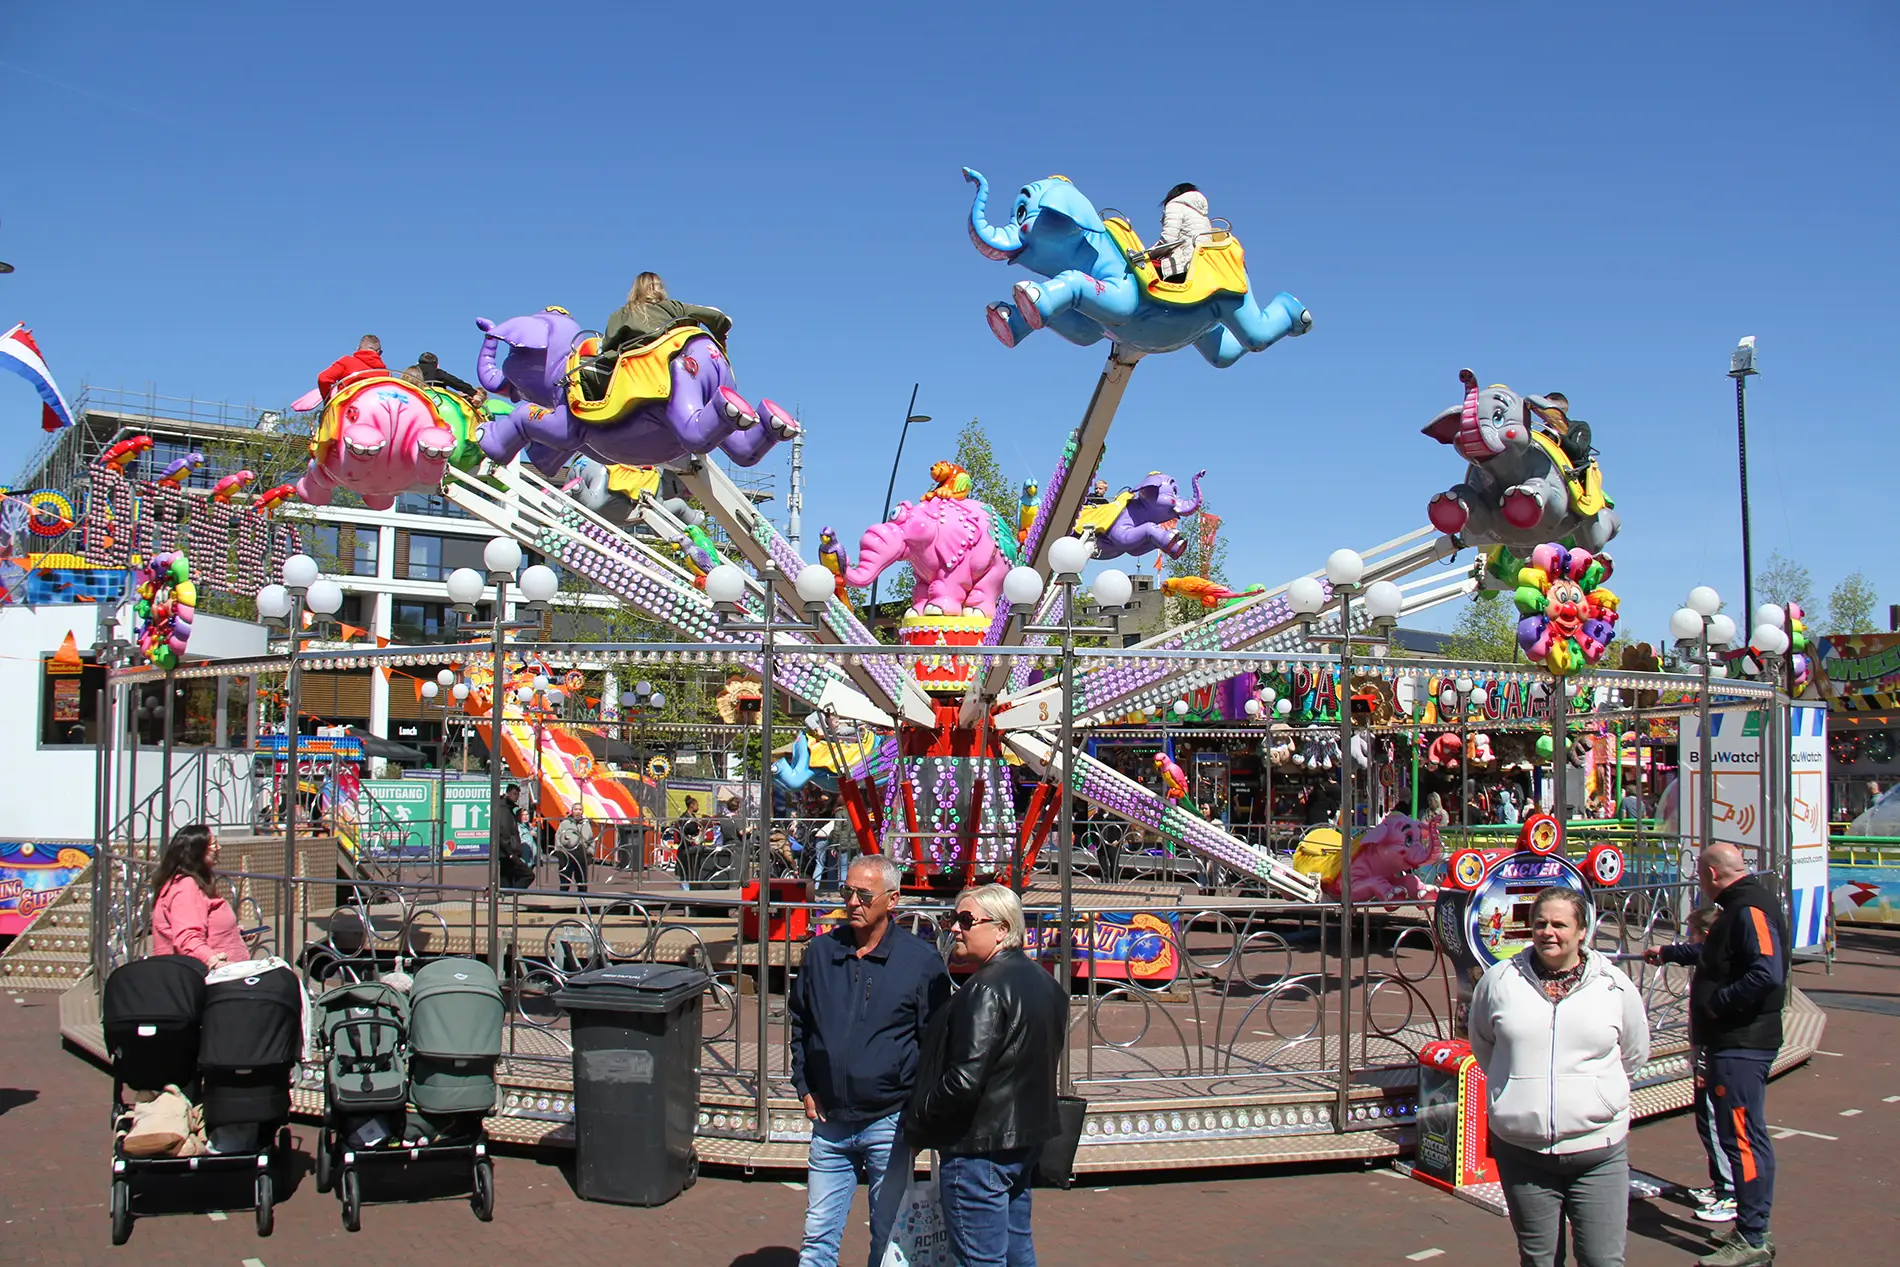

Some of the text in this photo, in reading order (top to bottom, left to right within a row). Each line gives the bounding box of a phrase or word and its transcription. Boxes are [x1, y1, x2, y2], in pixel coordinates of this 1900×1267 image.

[1039, 702, 1049, 721] 3
[399, 726, 418, 736] Lunch
[1690, 752, 1760, 763] BuWatch
[445, 787, 506, 800] NOODUITG
[1503, 863, 1560, 877] KICKER
